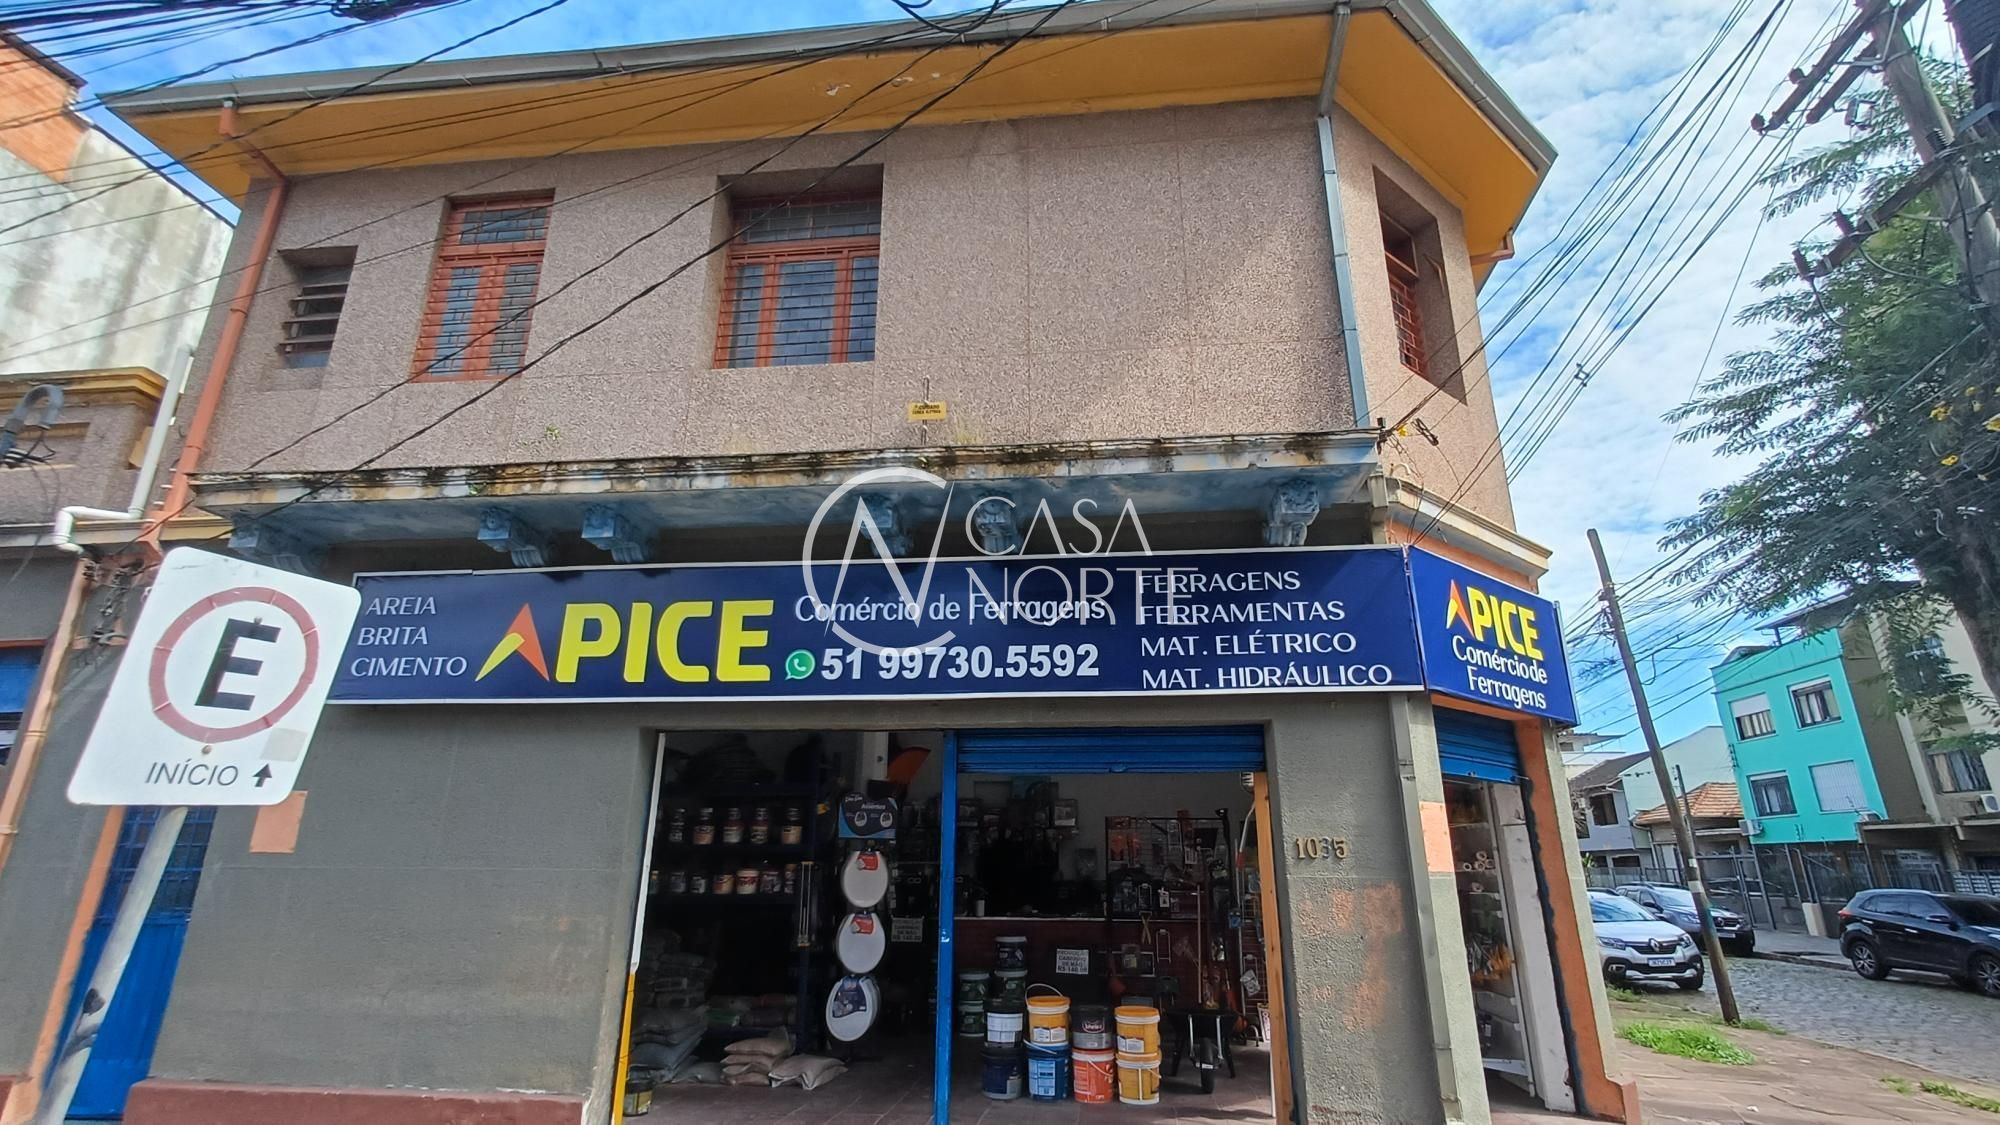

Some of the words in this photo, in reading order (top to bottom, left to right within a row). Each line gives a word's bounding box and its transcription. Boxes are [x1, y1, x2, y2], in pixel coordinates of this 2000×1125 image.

[1138, 570, 1302, 594] FERRAGENS
[365, 596, 437, 616] AREIA
[795, 594, 919, 622] Comércio
[929, 594, 961, 621] de
[971, 592, 1105, 626] Ferragens
[1139, 600, 1346, 625] FERRAMENTAS
[357, 627, 428, 647] BRITA
[1140, 636, 1208, 657] MAT.
[1216, 629, 1357, 656] ELÉTRICO
[194, 618, 281, 711] E
[350, 656, 468, 678] CIMENTO
[821, 647, 863, 680] 51
[878, 643, 1100, 680] 99730.5592
[1142, 668, 1211, 690] MAT.
[1217, 661, 1392, 688] HIDRÁULICO
[1466, 665, 1547, 709] Ferragens
[145, 758, 239, 787] INÍCIO
[1295, 835, 1349, 860] 1035
